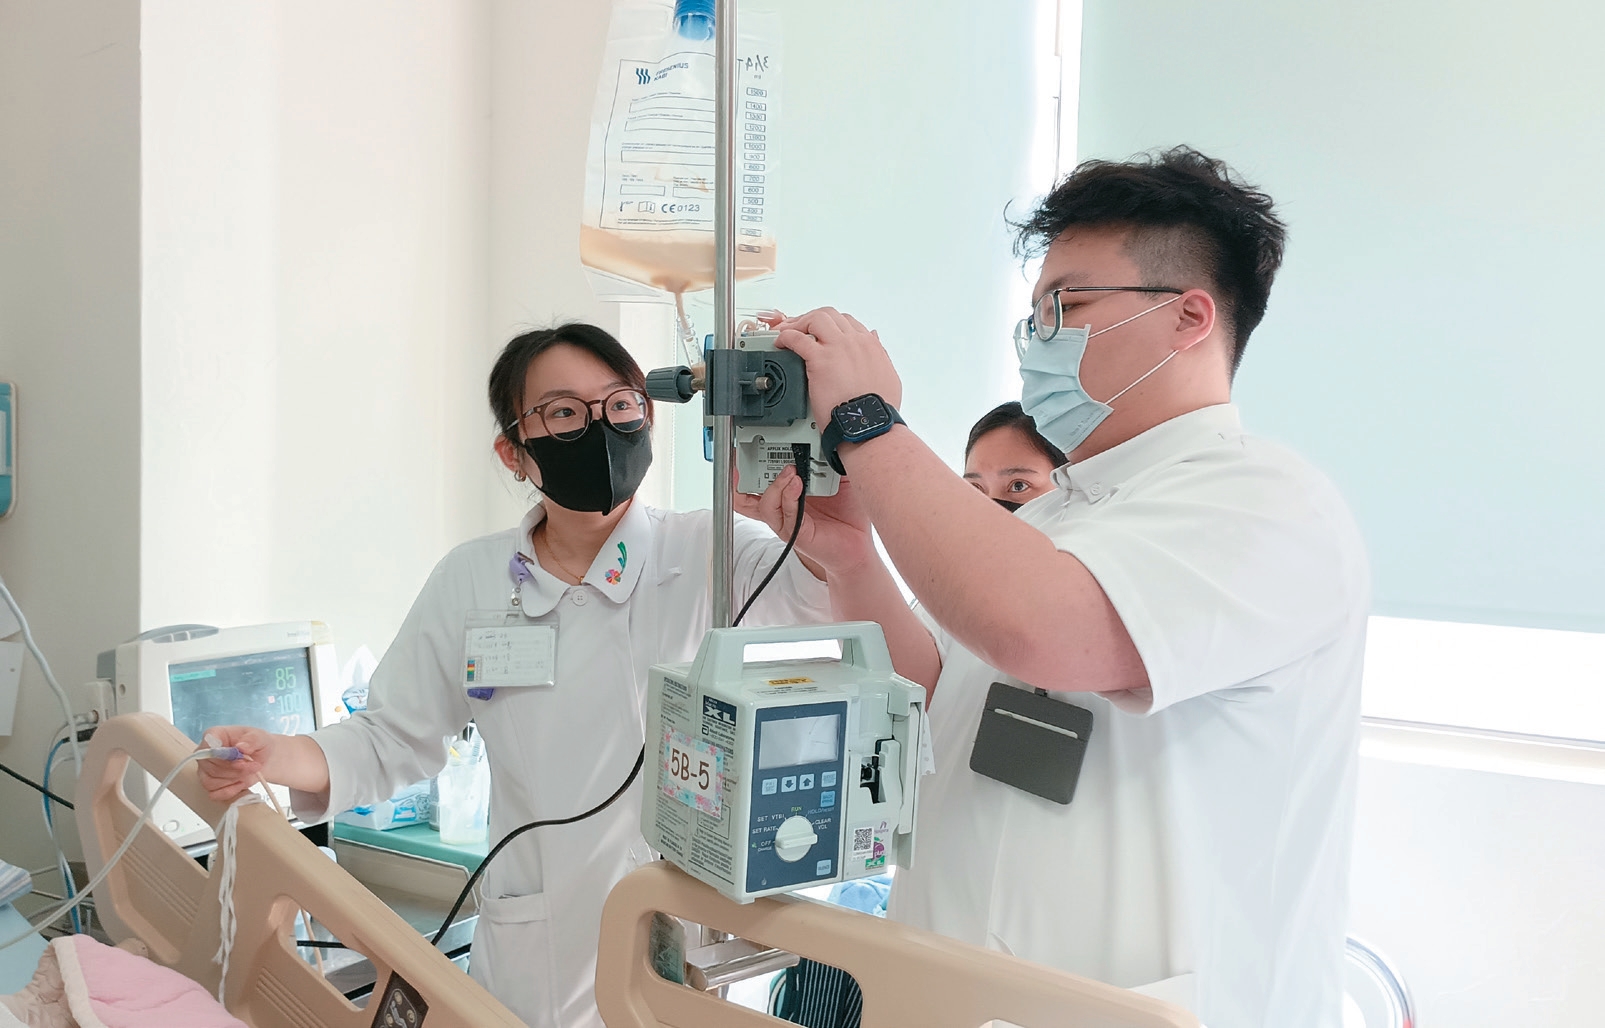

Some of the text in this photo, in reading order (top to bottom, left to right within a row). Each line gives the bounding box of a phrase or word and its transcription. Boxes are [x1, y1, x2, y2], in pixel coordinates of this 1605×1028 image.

[677, 204, 700, 212] 0123
[275, 666, 297, 690] 85
[277, 692, 304, 714] 100
[704, 705, 735, 725] XL
[671, 747, 710, 790] 5B-5
[757, 815, 768, 823] SET
[814, 817, 832, 825] CLEAR
[763, 825, 776, 833] RATE
